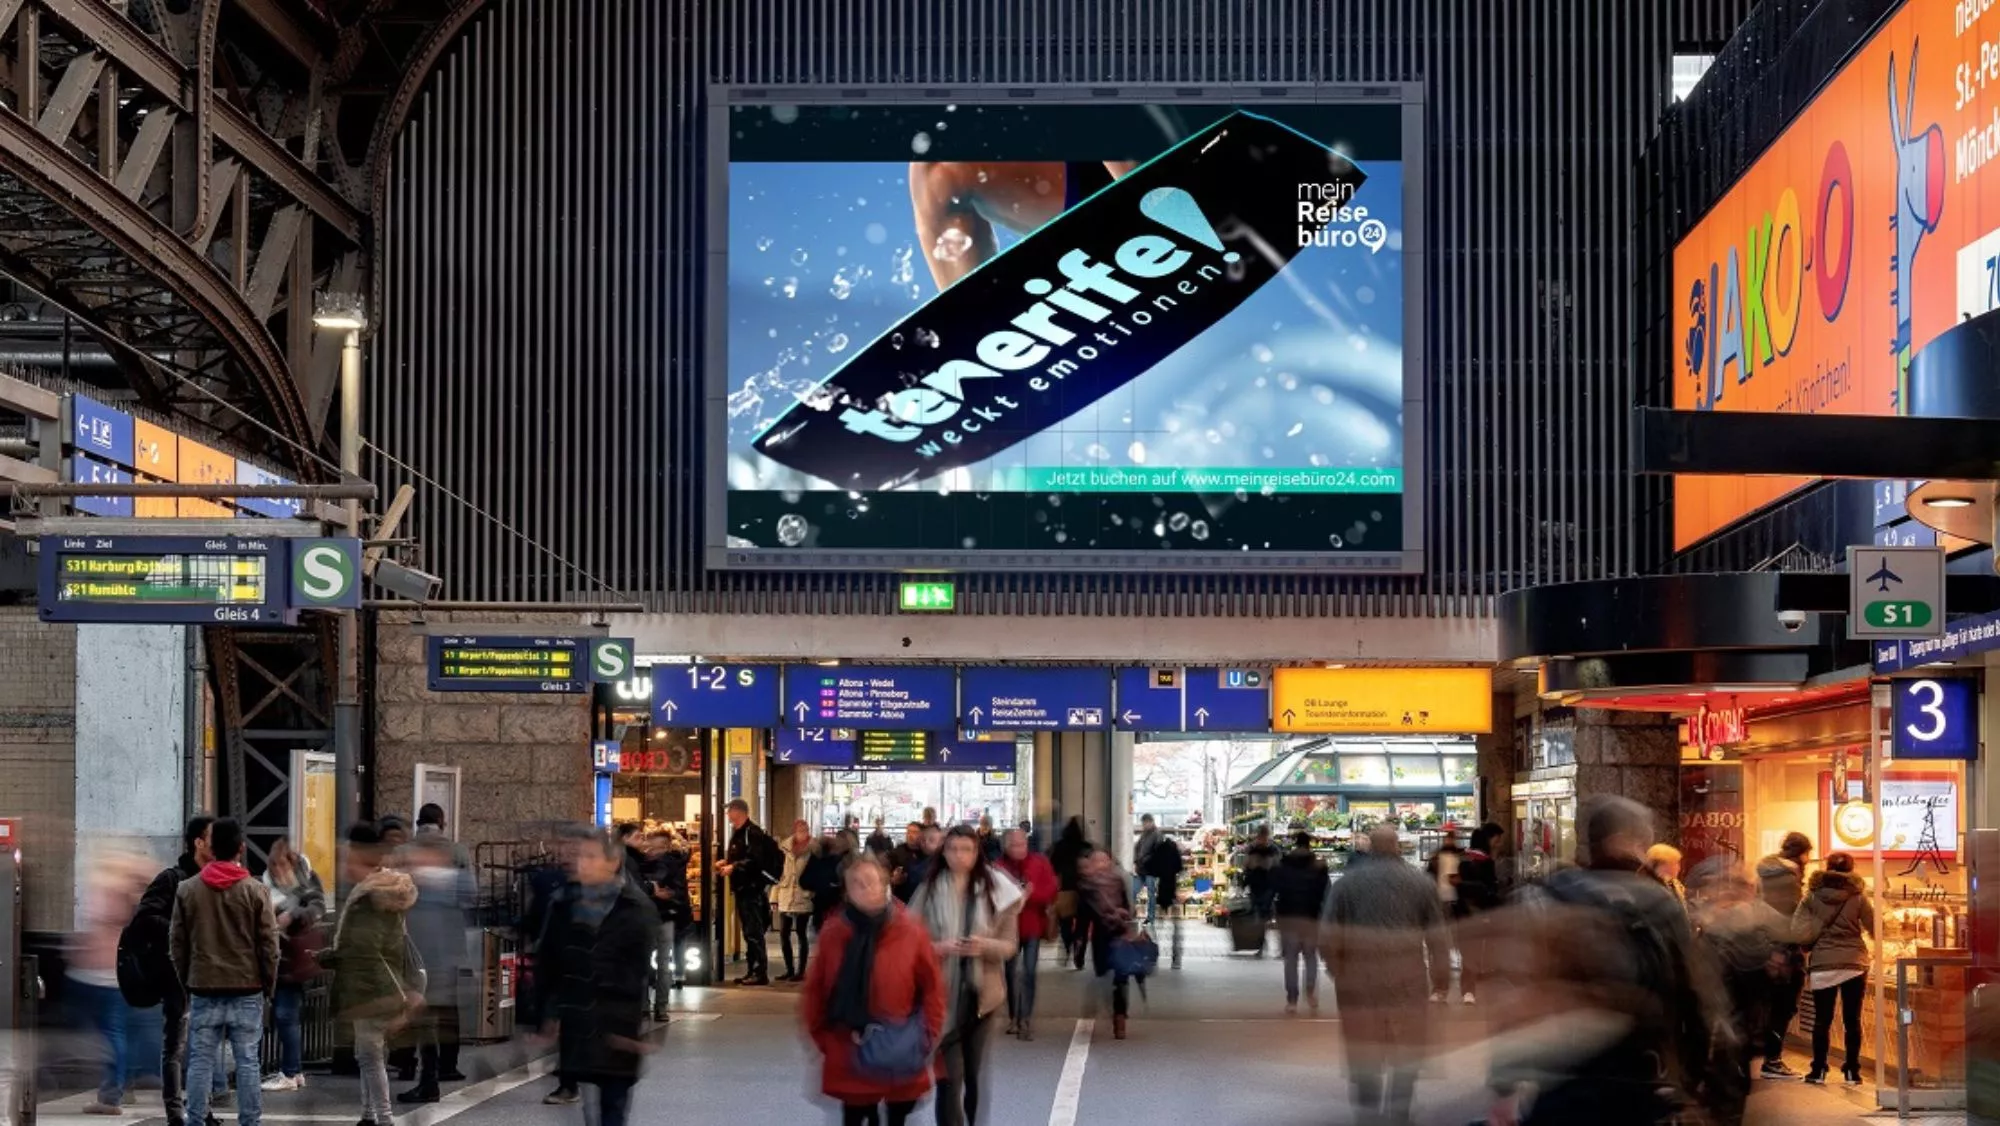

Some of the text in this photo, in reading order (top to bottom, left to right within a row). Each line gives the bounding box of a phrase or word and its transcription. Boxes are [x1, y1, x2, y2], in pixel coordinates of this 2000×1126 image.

[1955, 40, 2000, 111] St.-Pe
[1298, 178, 1355, 200] mein
[1298, 201, 1368, 223] Reise
[1298, 224, 1381, 247] büro 24
[838, 186, 1240, 443] tenerife!
[915, 263, 1222, 459] weckt emotionen
[1046, 470, 1395, 487] Jetzt buchen auf www.meinreisebüro24.com
[64, 540, 113, 549] Linie Ziel
[205, 540, 228, 550] Gleis
[66, 560, 87, 573] S31
[89, 560, 134, 574] Harburg
[303, 547, 343, 598] S
[214, 608, 261, 621] Gleis 4
[597, 643, 624, 676] S
[687, 665, 755, 690] 1-2 S
[1229, 671, 1241, 686] U
[1318, 699, 1348, 708] Lounge
[1906, 679, 1946, 741] 3
